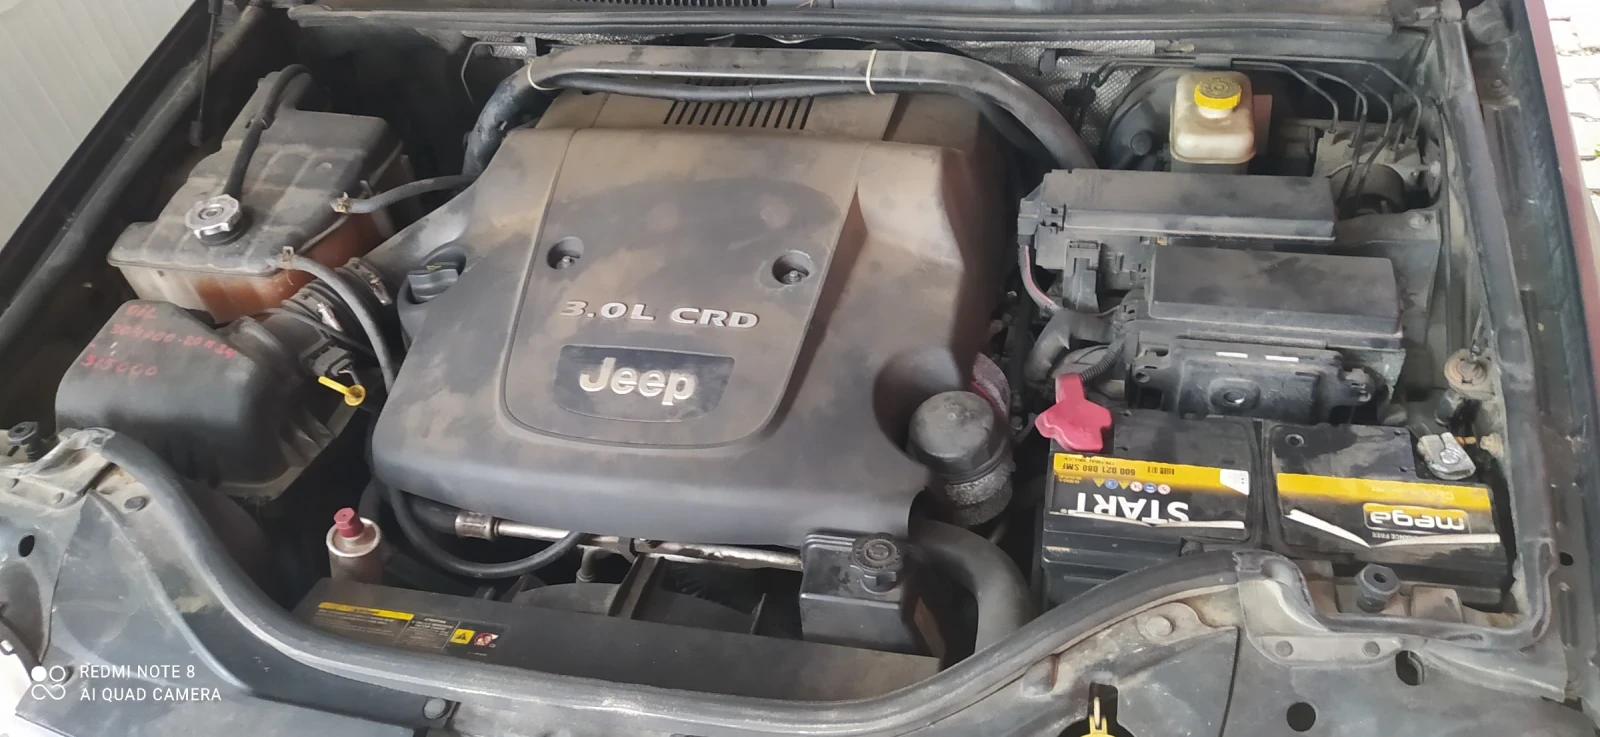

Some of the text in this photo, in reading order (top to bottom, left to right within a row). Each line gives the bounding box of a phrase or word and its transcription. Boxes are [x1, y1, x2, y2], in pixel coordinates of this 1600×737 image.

[560, 301, 760, 328] 3.0L CRD
[579, 357, 697, 406] Jeep
[1069, 492, 1190, 525] START
[1370, 509, 1465, 530] mega
